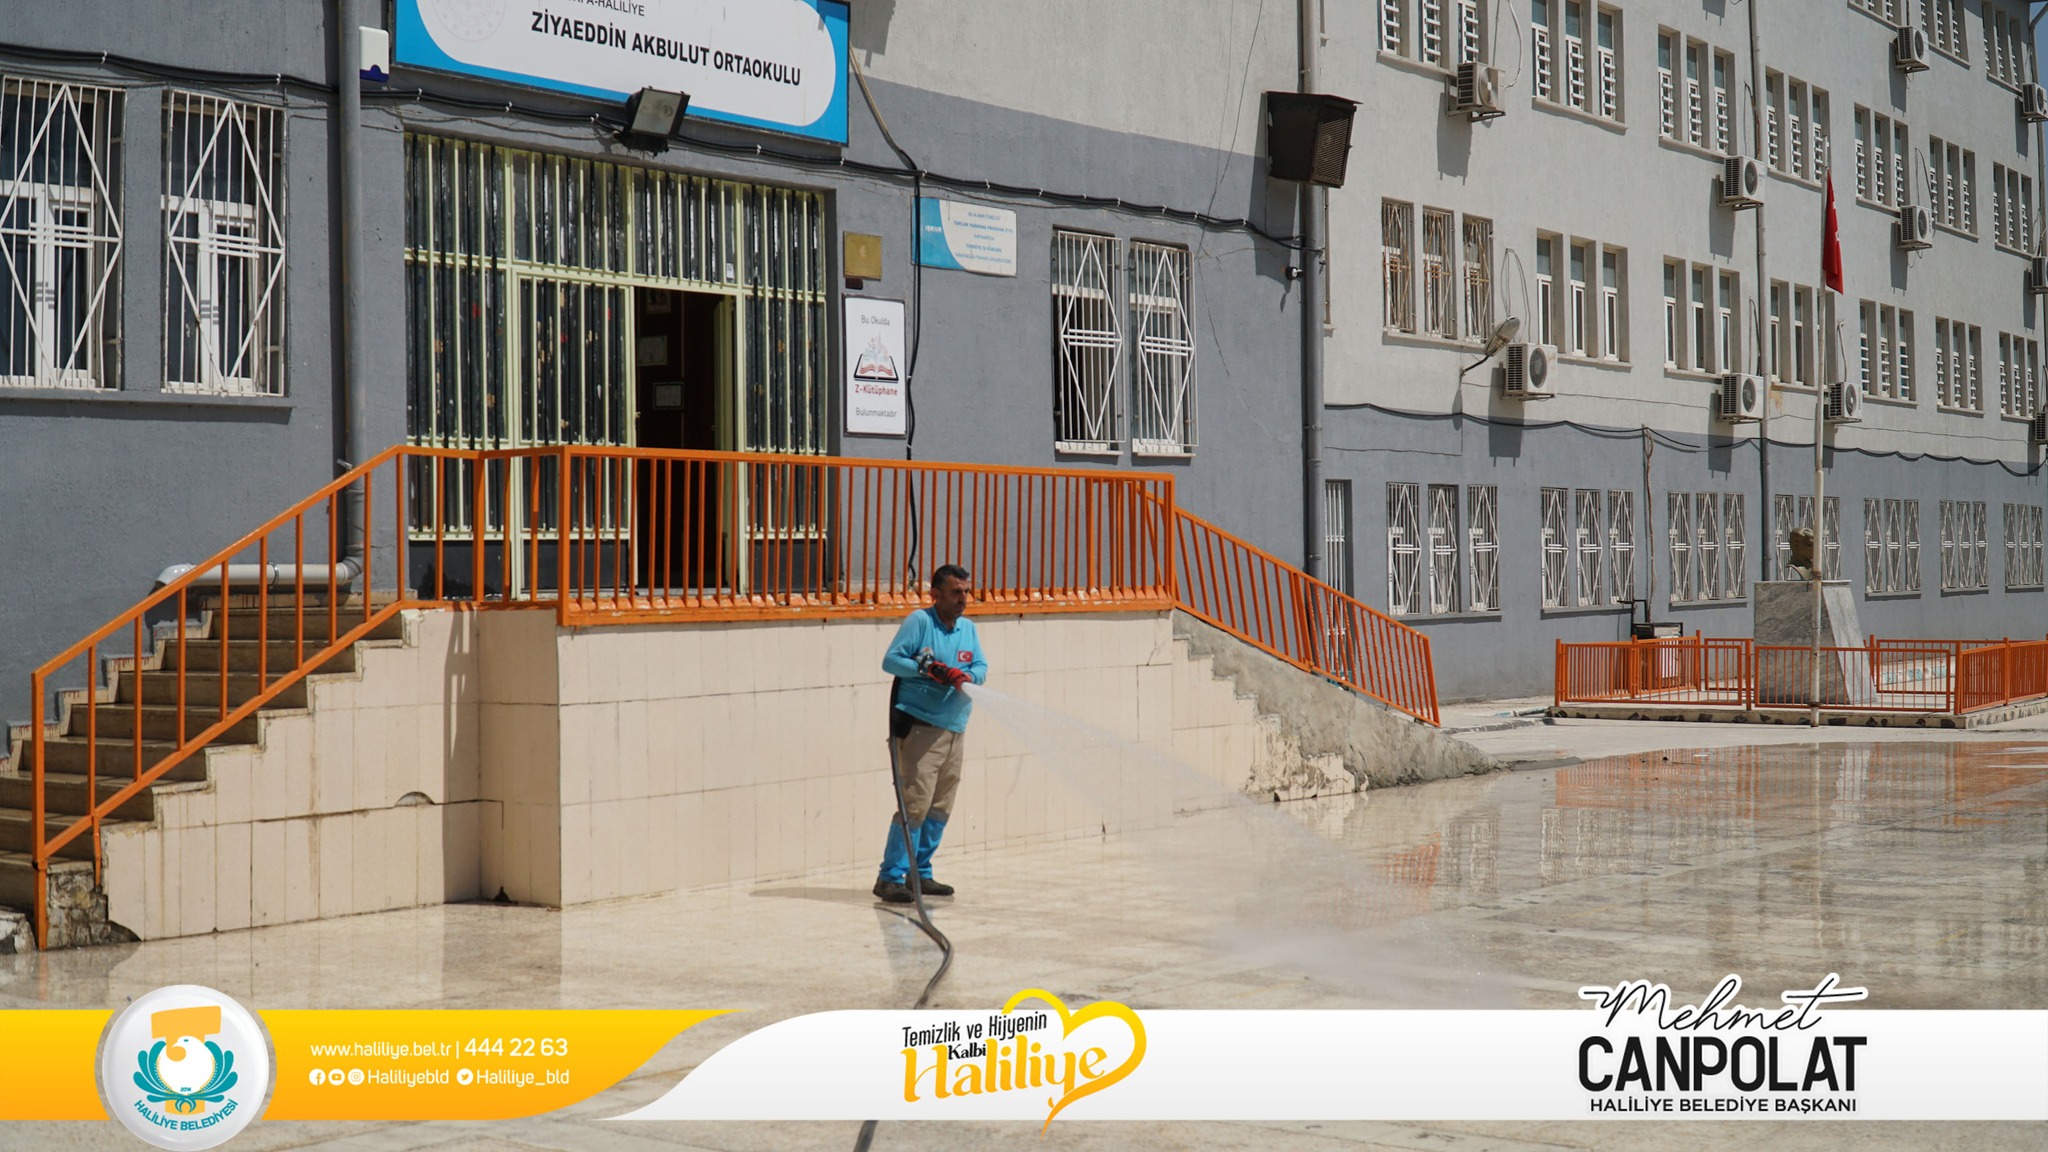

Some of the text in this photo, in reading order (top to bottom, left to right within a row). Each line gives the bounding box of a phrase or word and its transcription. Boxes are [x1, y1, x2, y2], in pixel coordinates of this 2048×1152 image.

[531, 8, 801, 86] ZİYAEDDİN AKBULUT ORTAOKULU
[861, 315, 890, 326] Bu Okulda
[855, 384, 898, 396] Z-Kütüphane
[855, 407, 897, 418] Bulunmaktadır
